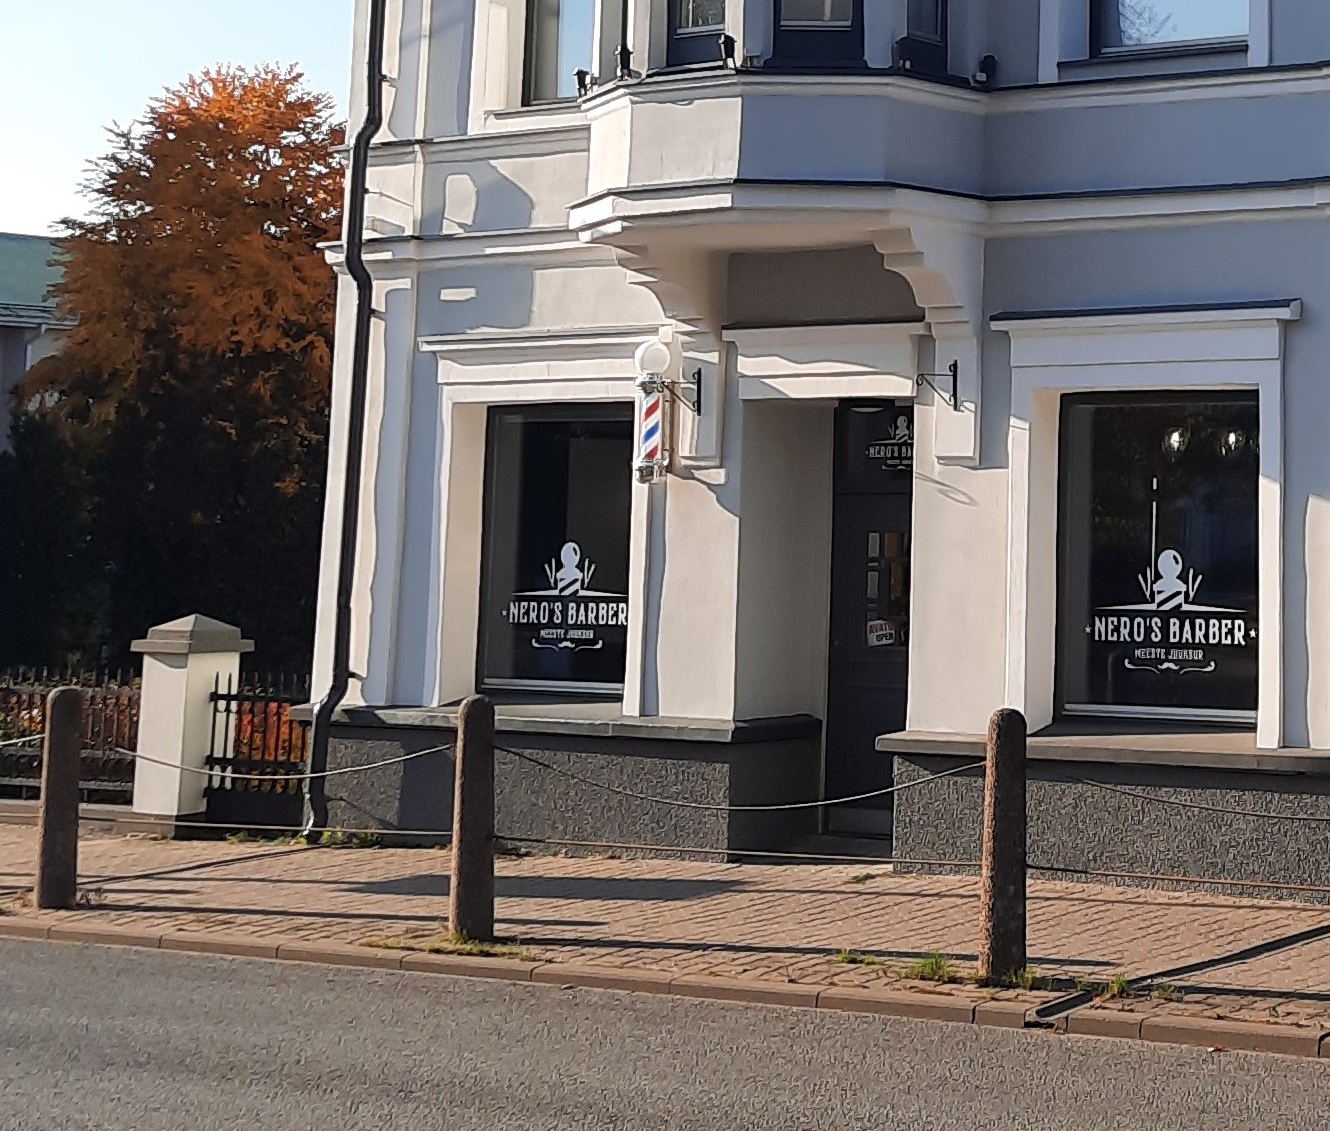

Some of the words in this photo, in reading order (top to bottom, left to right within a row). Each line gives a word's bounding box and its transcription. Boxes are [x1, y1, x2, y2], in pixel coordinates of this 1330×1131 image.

[868, 445, 899, 458] NERO'S
[509, 601, 563, 624] NERO'S
[567, 602, 628, 626] BARBER
[875, 631, 894, 642] OPEN
[1094, 615, 1162, 643] NERO'S
[1169, 618, 1246, 646] BARBER
